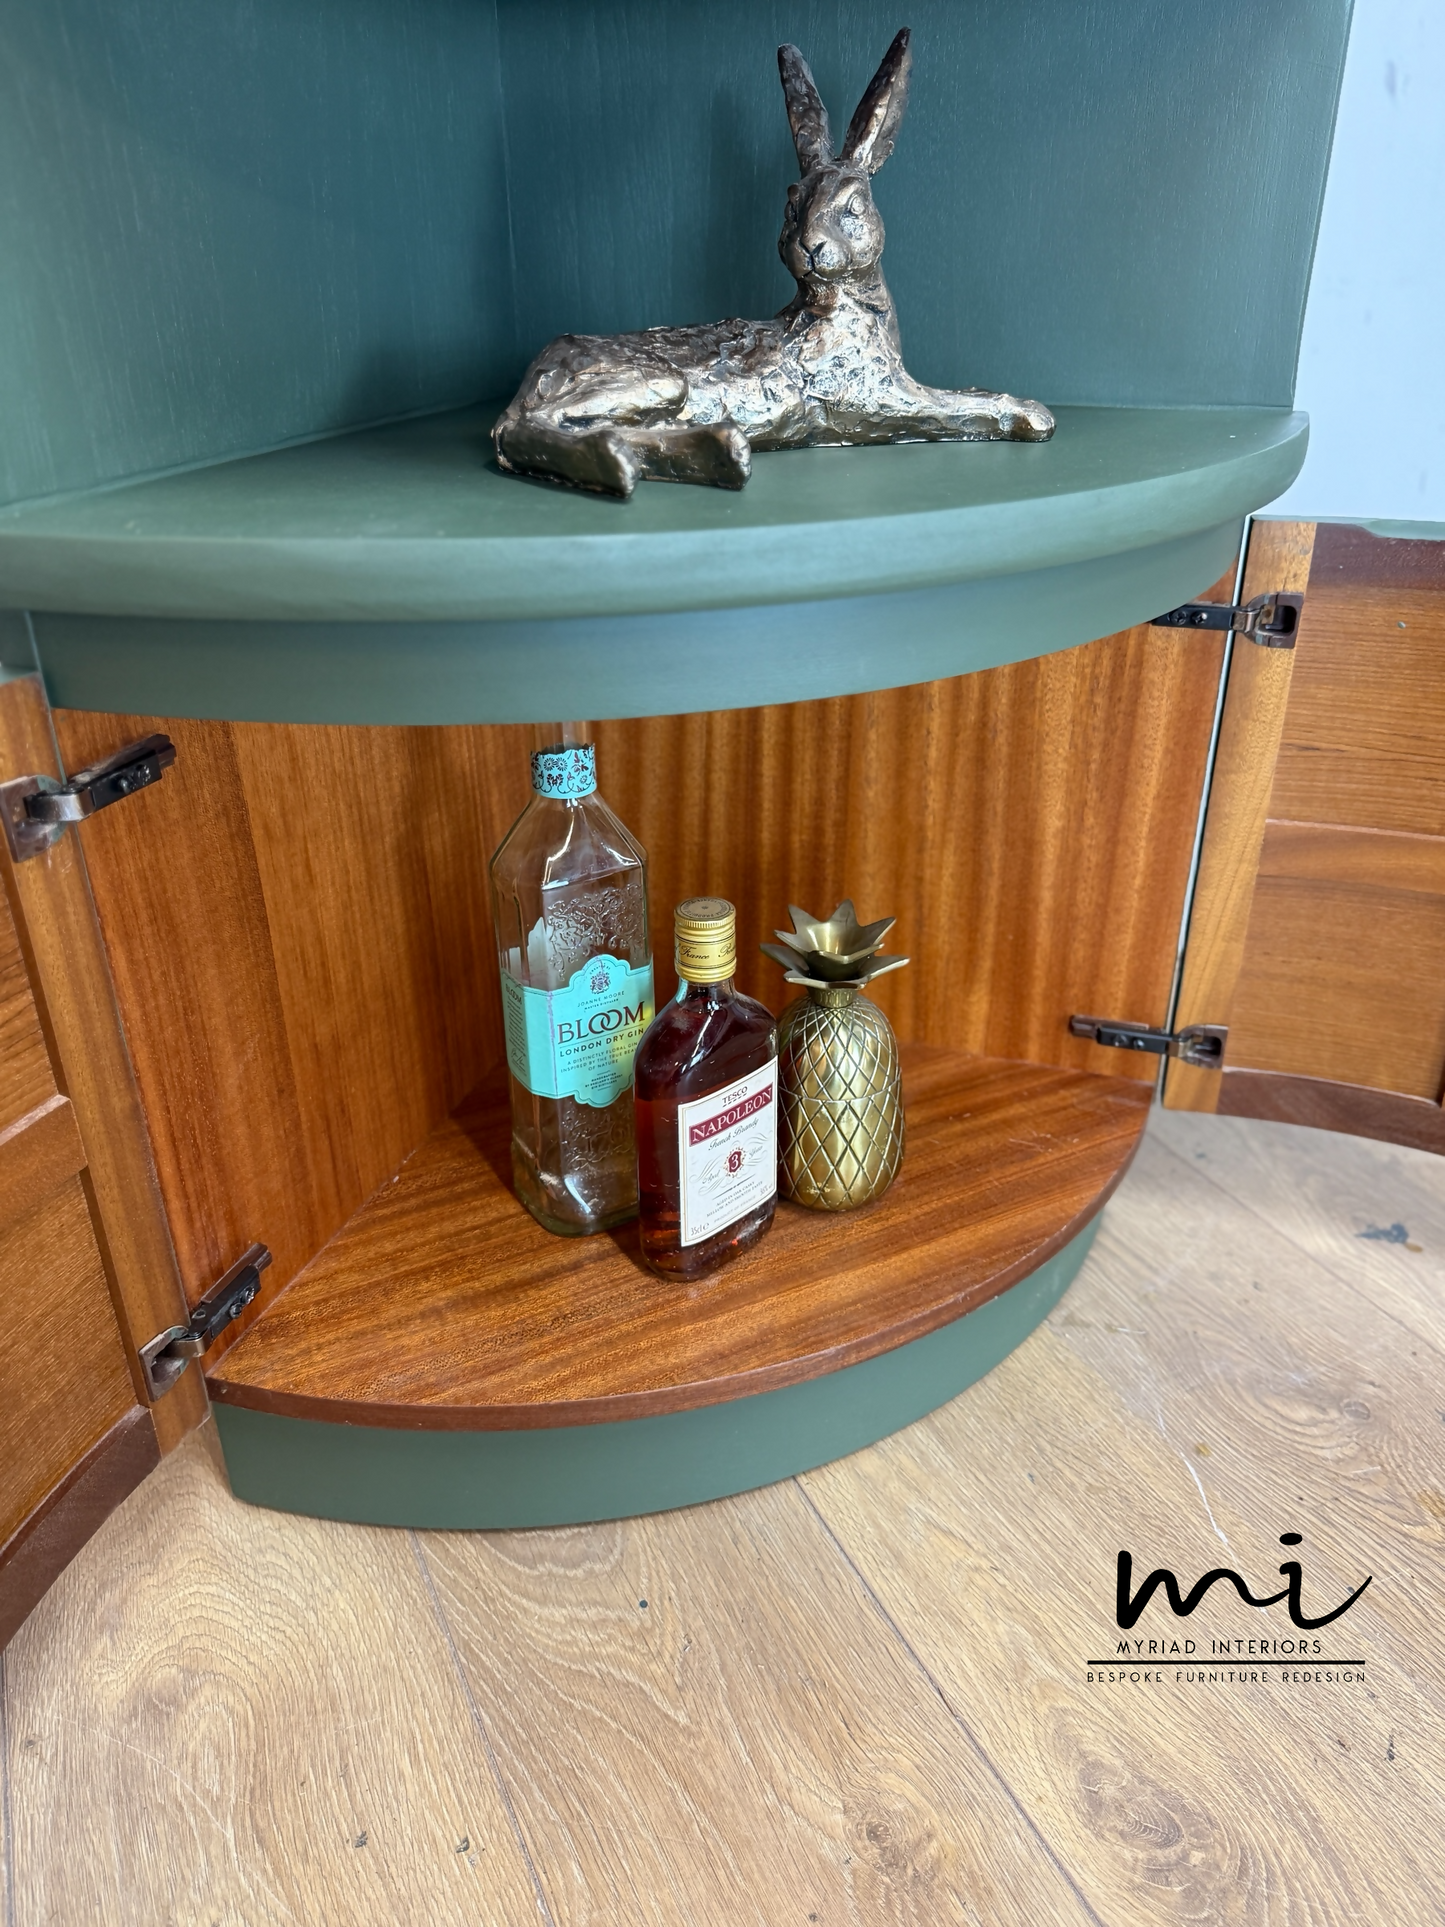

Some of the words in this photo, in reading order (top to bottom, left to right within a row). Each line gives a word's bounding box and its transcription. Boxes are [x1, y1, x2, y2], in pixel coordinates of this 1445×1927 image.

[679, 945, 710, 959] France
[577, 997, 602, 1008] JOANNE
[604, 990, 625, 1000] MOORE
[557, 1001, 645, 1045] BLOOM
[560, 1040, 602, 1057] LONDON
[606, 1033, 625, 1044] DRY
[627, 1027, 644, 1038] GIN
[573, 1051, 604, 1064] DISTINCTLY
[606, 1045, 626, 1054] FLORAL
[598, 1059, 618, 1068] NATURE
[561, 1063, 587, 1073] INSPIRED
[722, 1086, 748, 1104] TESCO
[692, 1087, 772, 1142] NAPOLEON
[708, 1132, 732, 1151] French
[731, 1153, 739, 1170] 3
